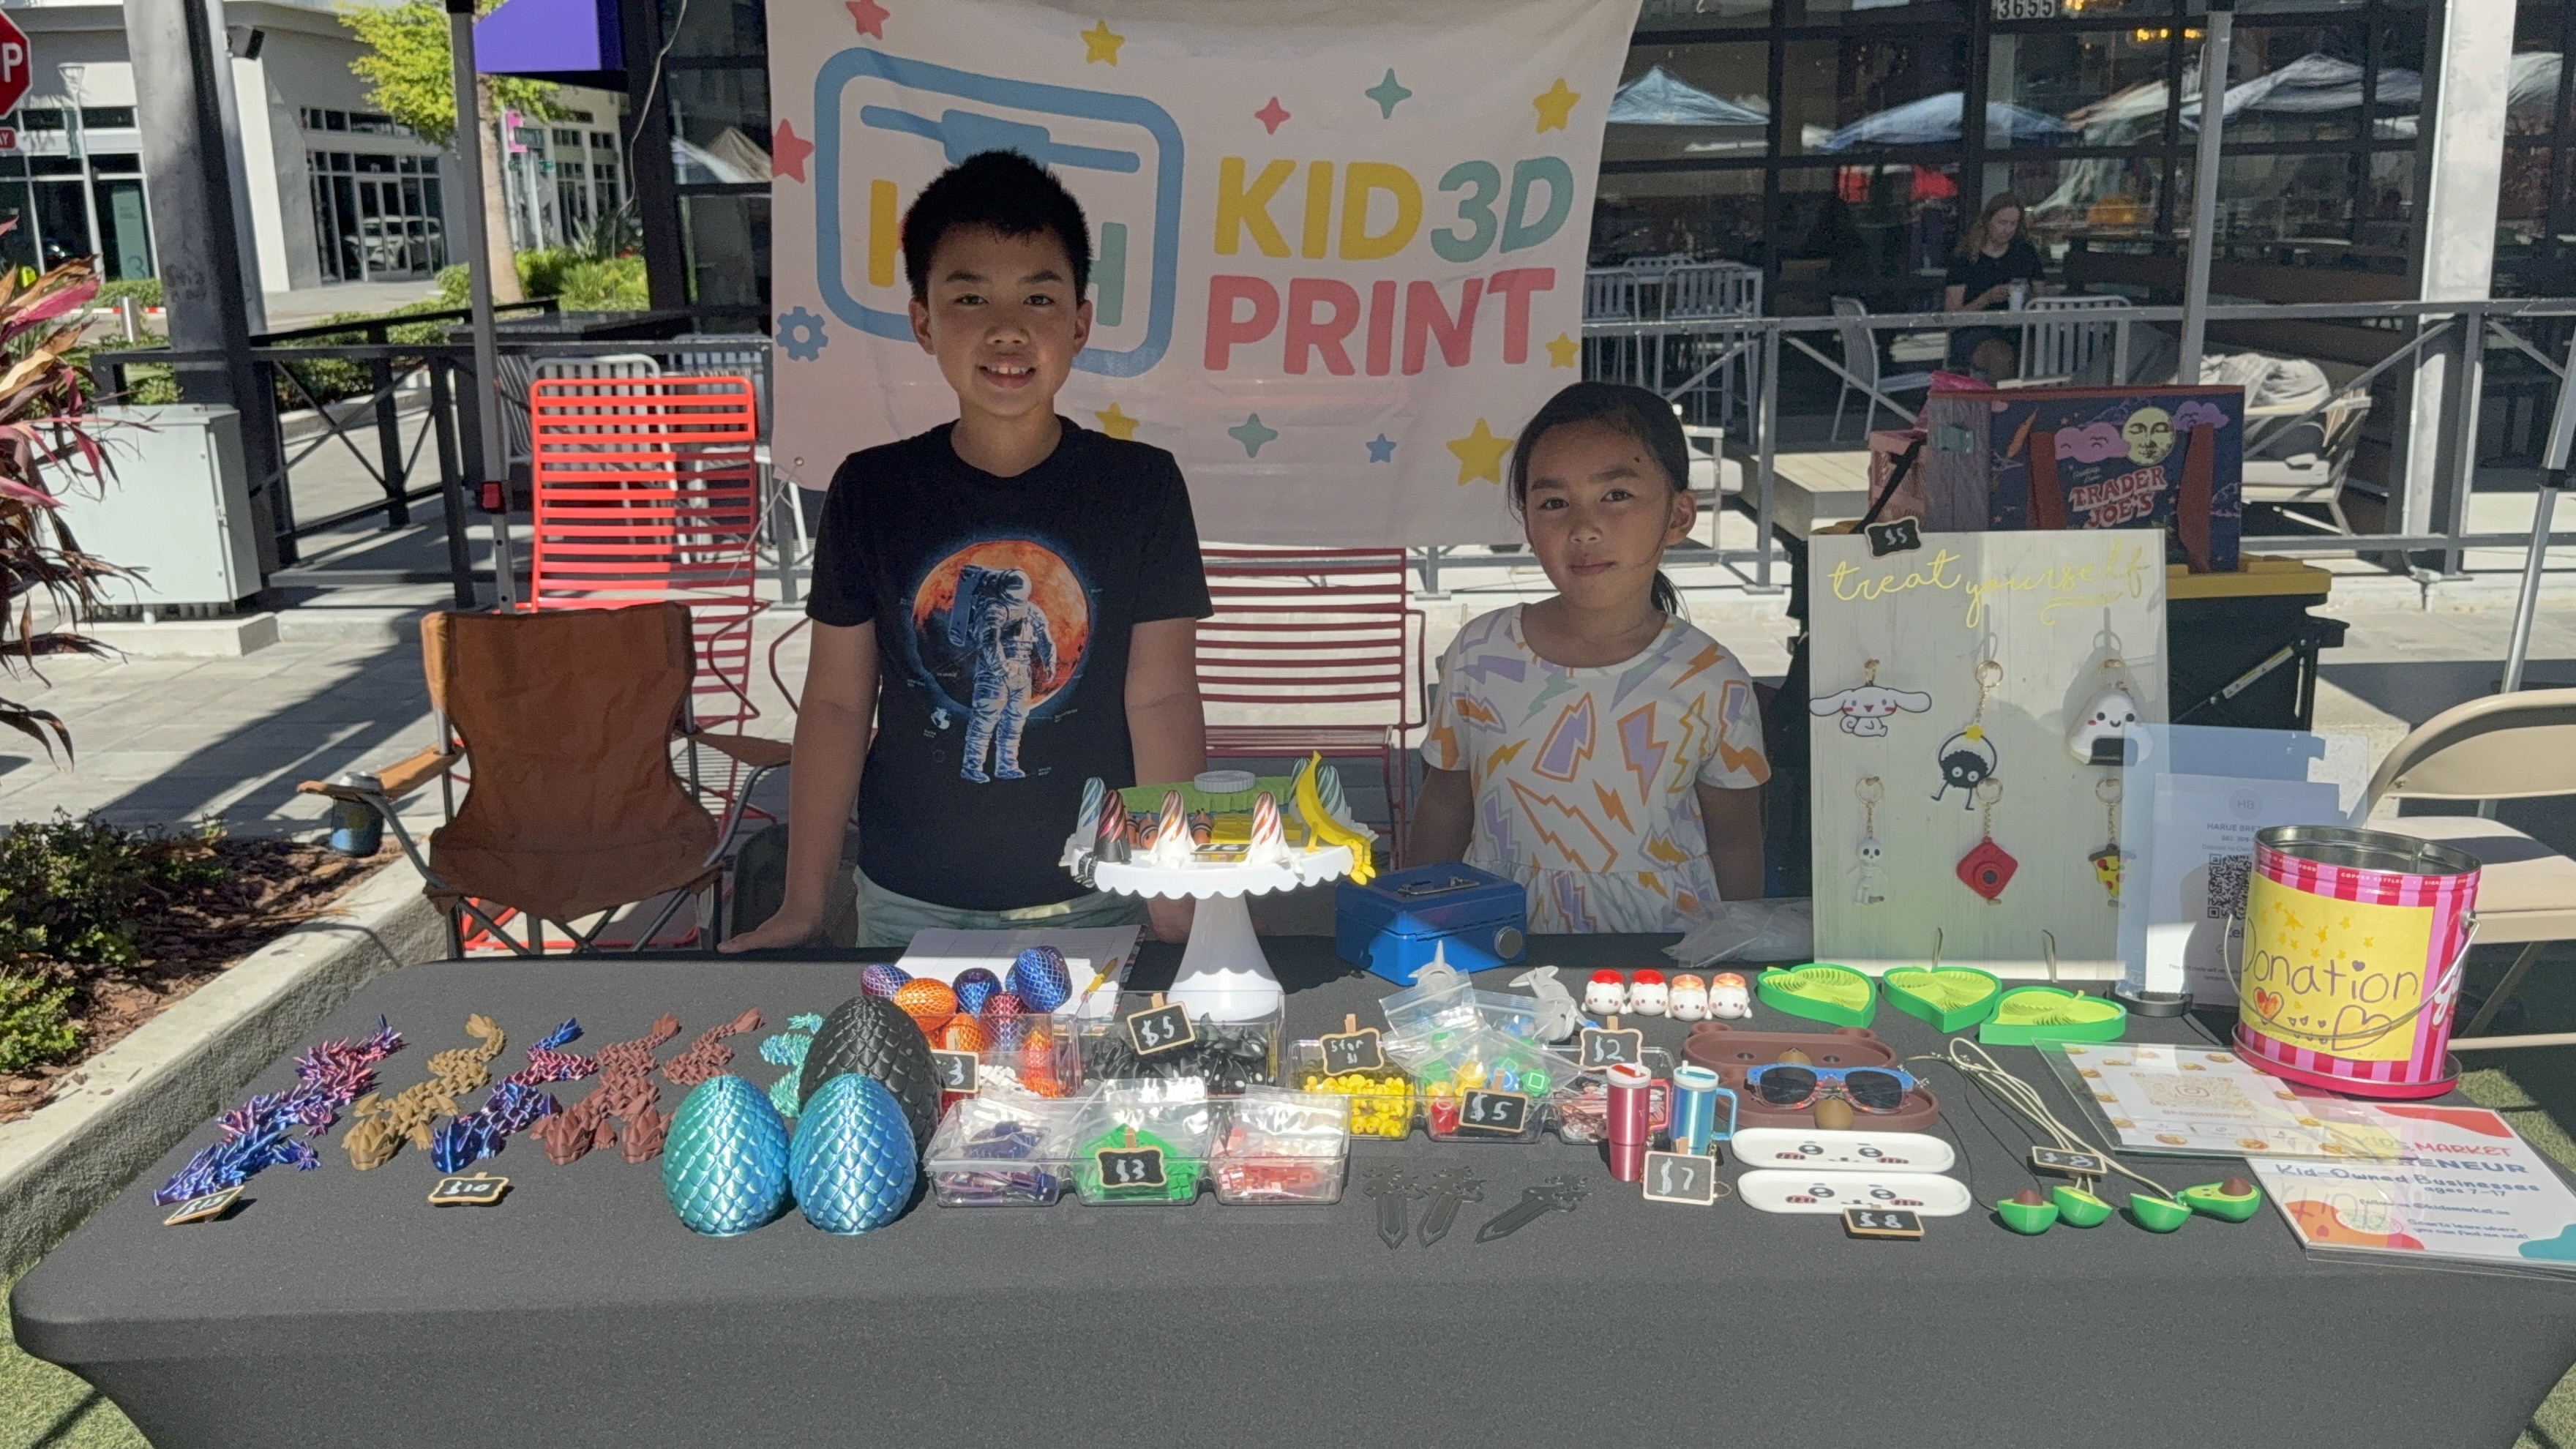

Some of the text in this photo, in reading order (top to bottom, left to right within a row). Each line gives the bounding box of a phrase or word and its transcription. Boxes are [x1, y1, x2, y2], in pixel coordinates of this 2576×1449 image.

[1999, 0, 2052, 18] 3655
[1203, 267, 1556, 376] PRINT
[2069, 465, 2168, 512] TRADER
[2083, 491, 2155, 529] JOE'S
[1885, 527, 1907, 546] $5
[1827, 536, 2151, 629] treat yourself
[2237, 800, 2255, 810] HB
[2206, 823, 2264, 833] HARUE BREZ
[2299, 864, 2317, 872] FOOD
[2243, 916, 2419, 1003] Donation
[1141, 1015, 1175, 1047] $5
[1593, 1035, 1625, 1063] $2
[1469, 1091, 1513, 1122] $5
[2043, 1152, 2094, 1167] $8
[2414, 1142, 2512, 1157] MARKET
[1116, 1158, 1145, 1182] $3
[1656, 1157, 1695, 1195] $7
[2275, 1164, 2541, 1191] Kid-Owned Businesses
[443, 1180, 492, 1195] $10
[2424, 1186, 2465, 1194] ages
[1860, 1212, 1903, 1229] $8
